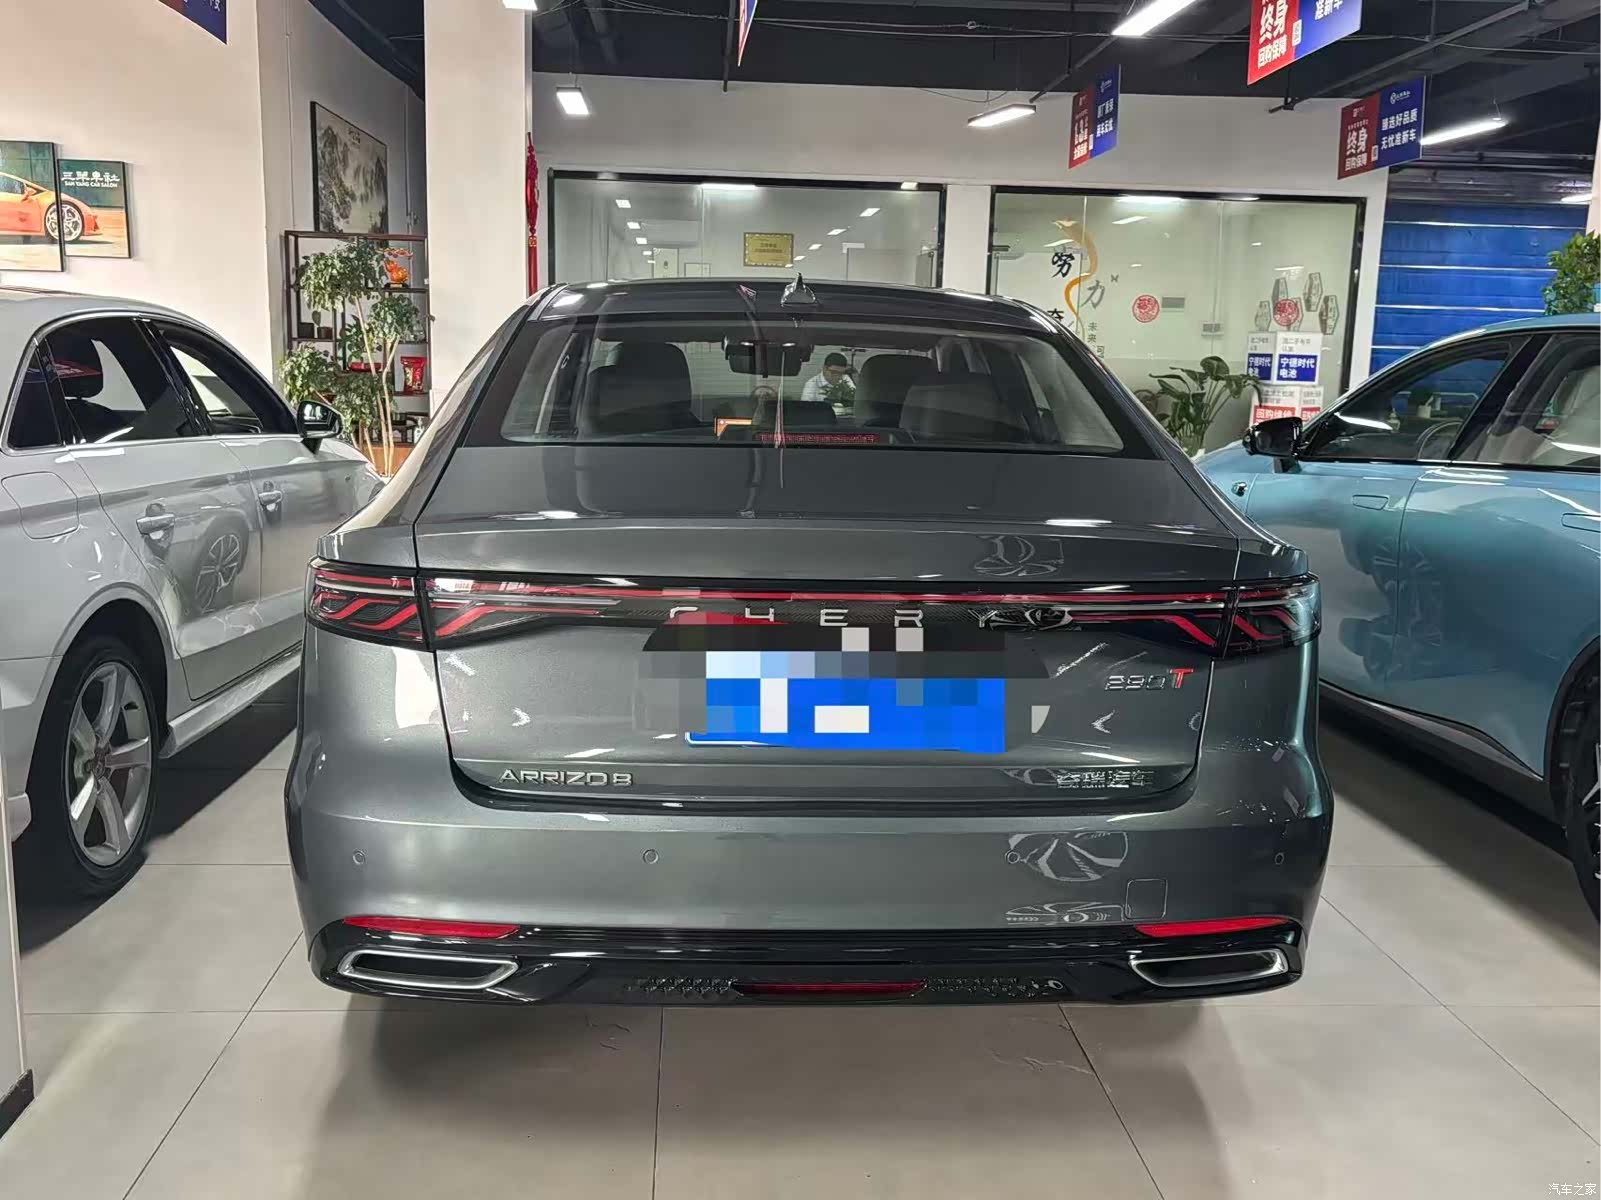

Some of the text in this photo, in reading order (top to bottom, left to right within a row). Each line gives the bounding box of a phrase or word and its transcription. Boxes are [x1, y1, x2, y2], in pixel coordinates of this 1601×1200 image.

[1259, 0, 1288, 44] 终身
[1257, 35, 1287, 69] 回购保障
[1346, 127, 1368, 156] 终身
[1381, 128, 1416, 150] 无忧准新车
[1248, 356, 1271, 368] 宁德时代
[1280, 357, 1315, 369] 宁德时代
[1279, 368, 1297, 379] 电池
